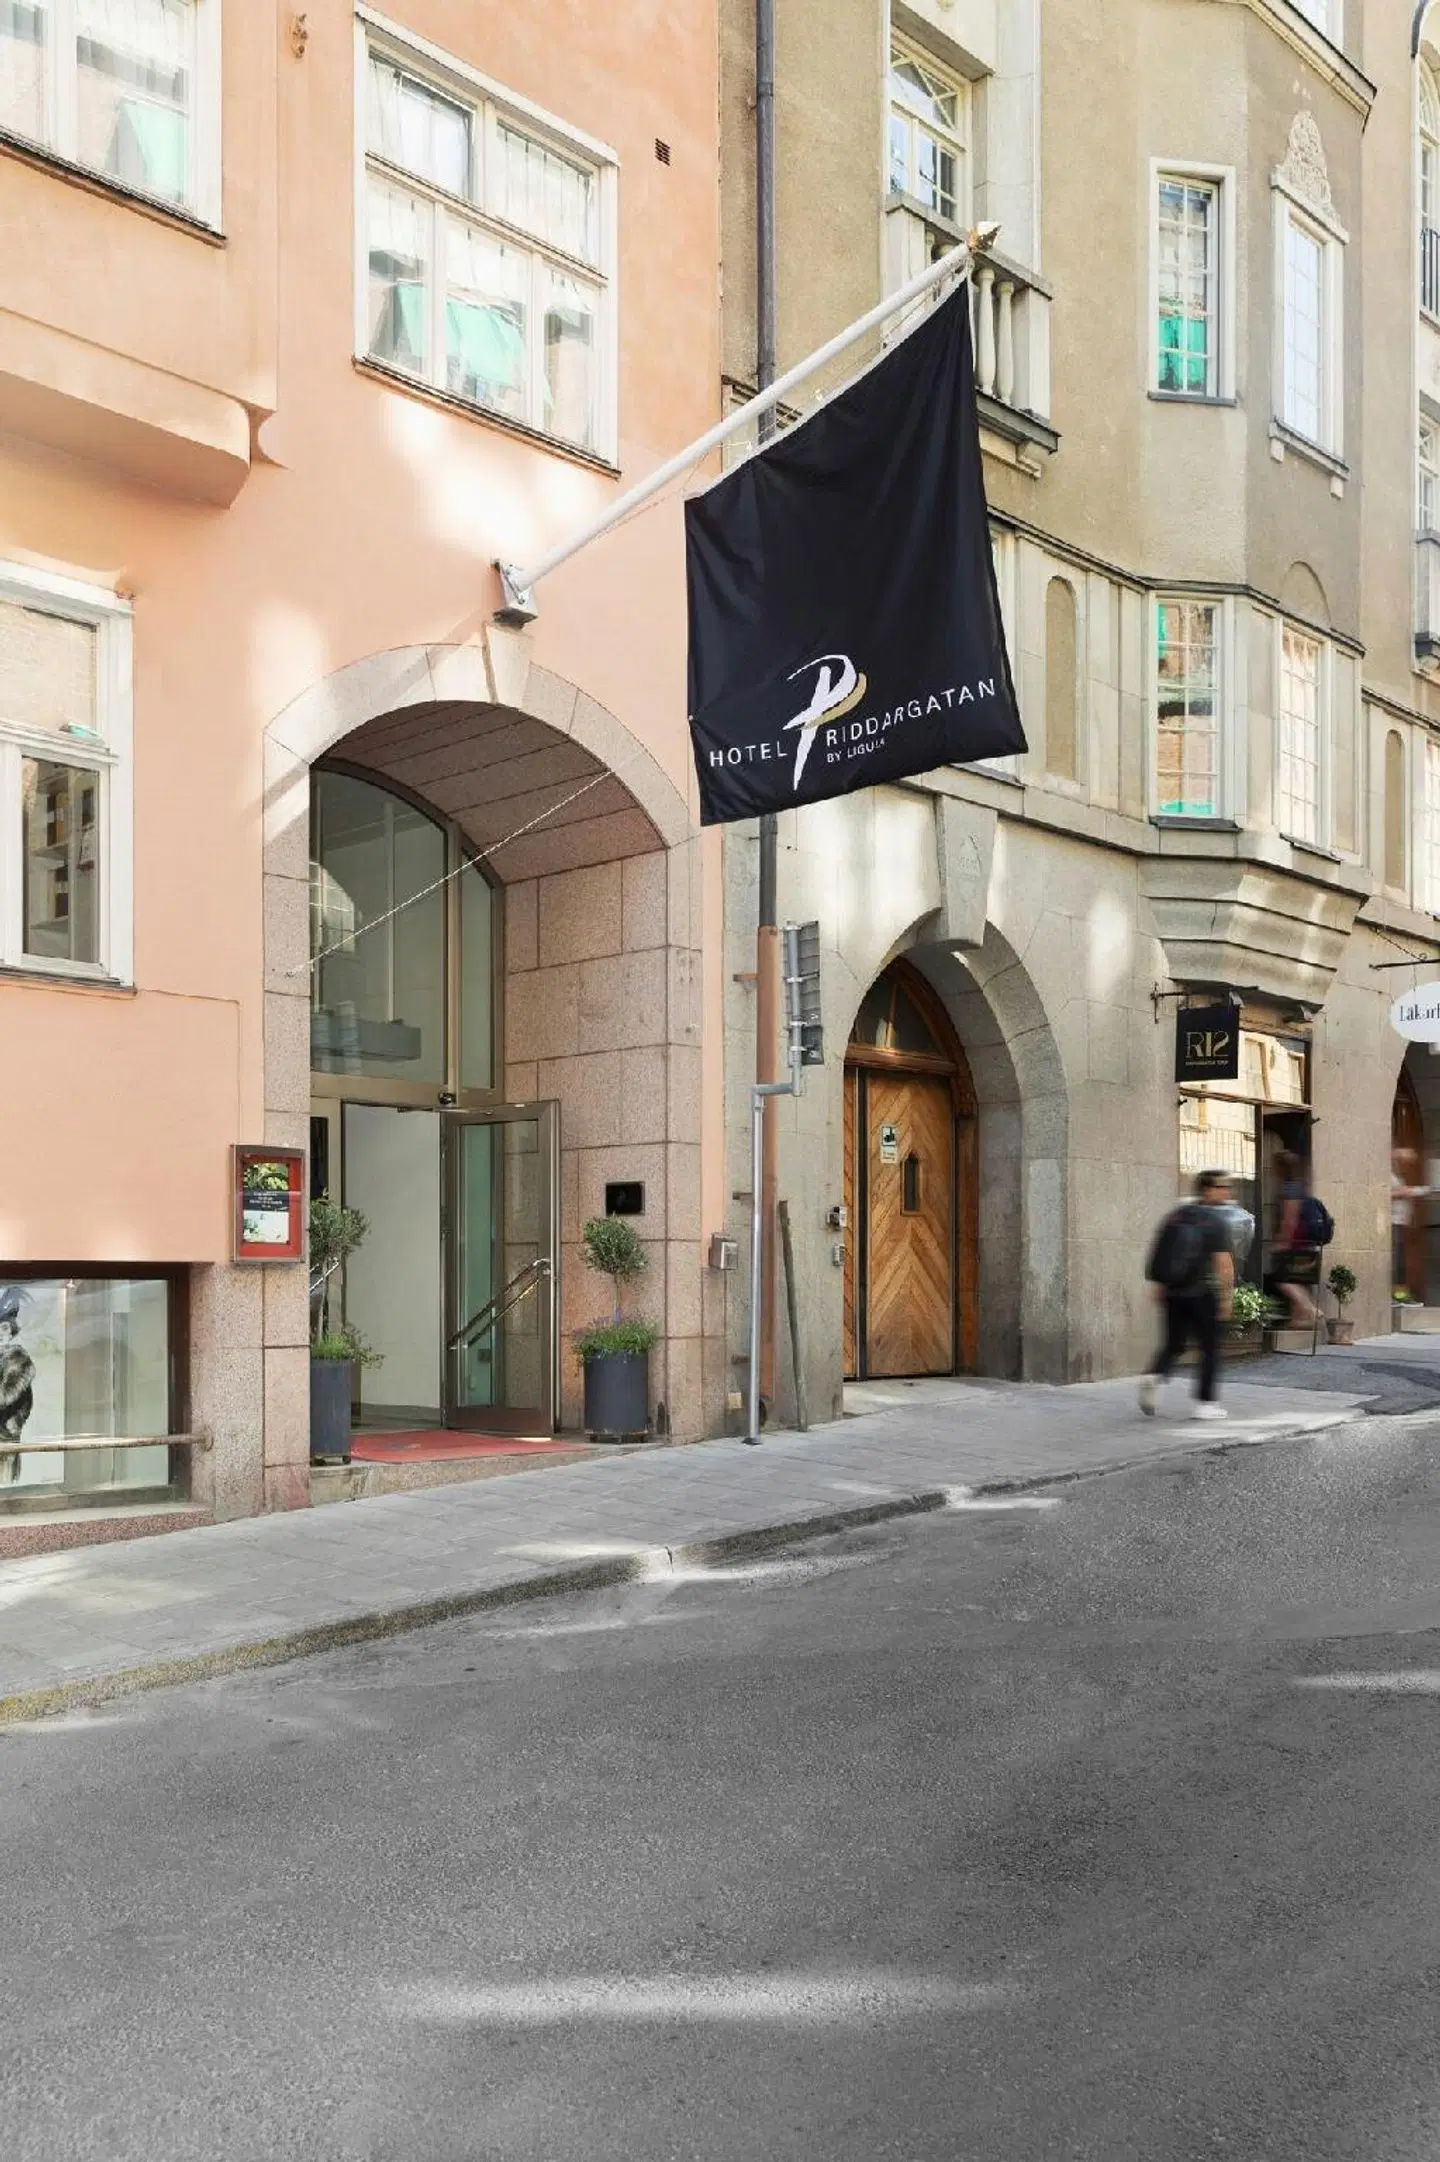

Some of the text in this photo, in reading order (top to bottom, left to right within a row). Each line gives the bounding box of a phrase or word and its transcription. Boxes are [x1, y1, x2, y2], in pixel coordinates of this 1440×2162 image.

[709, 678, 995, 767] HOTEL RIDDARGATAN
[827, 750, 841, 763] BY
